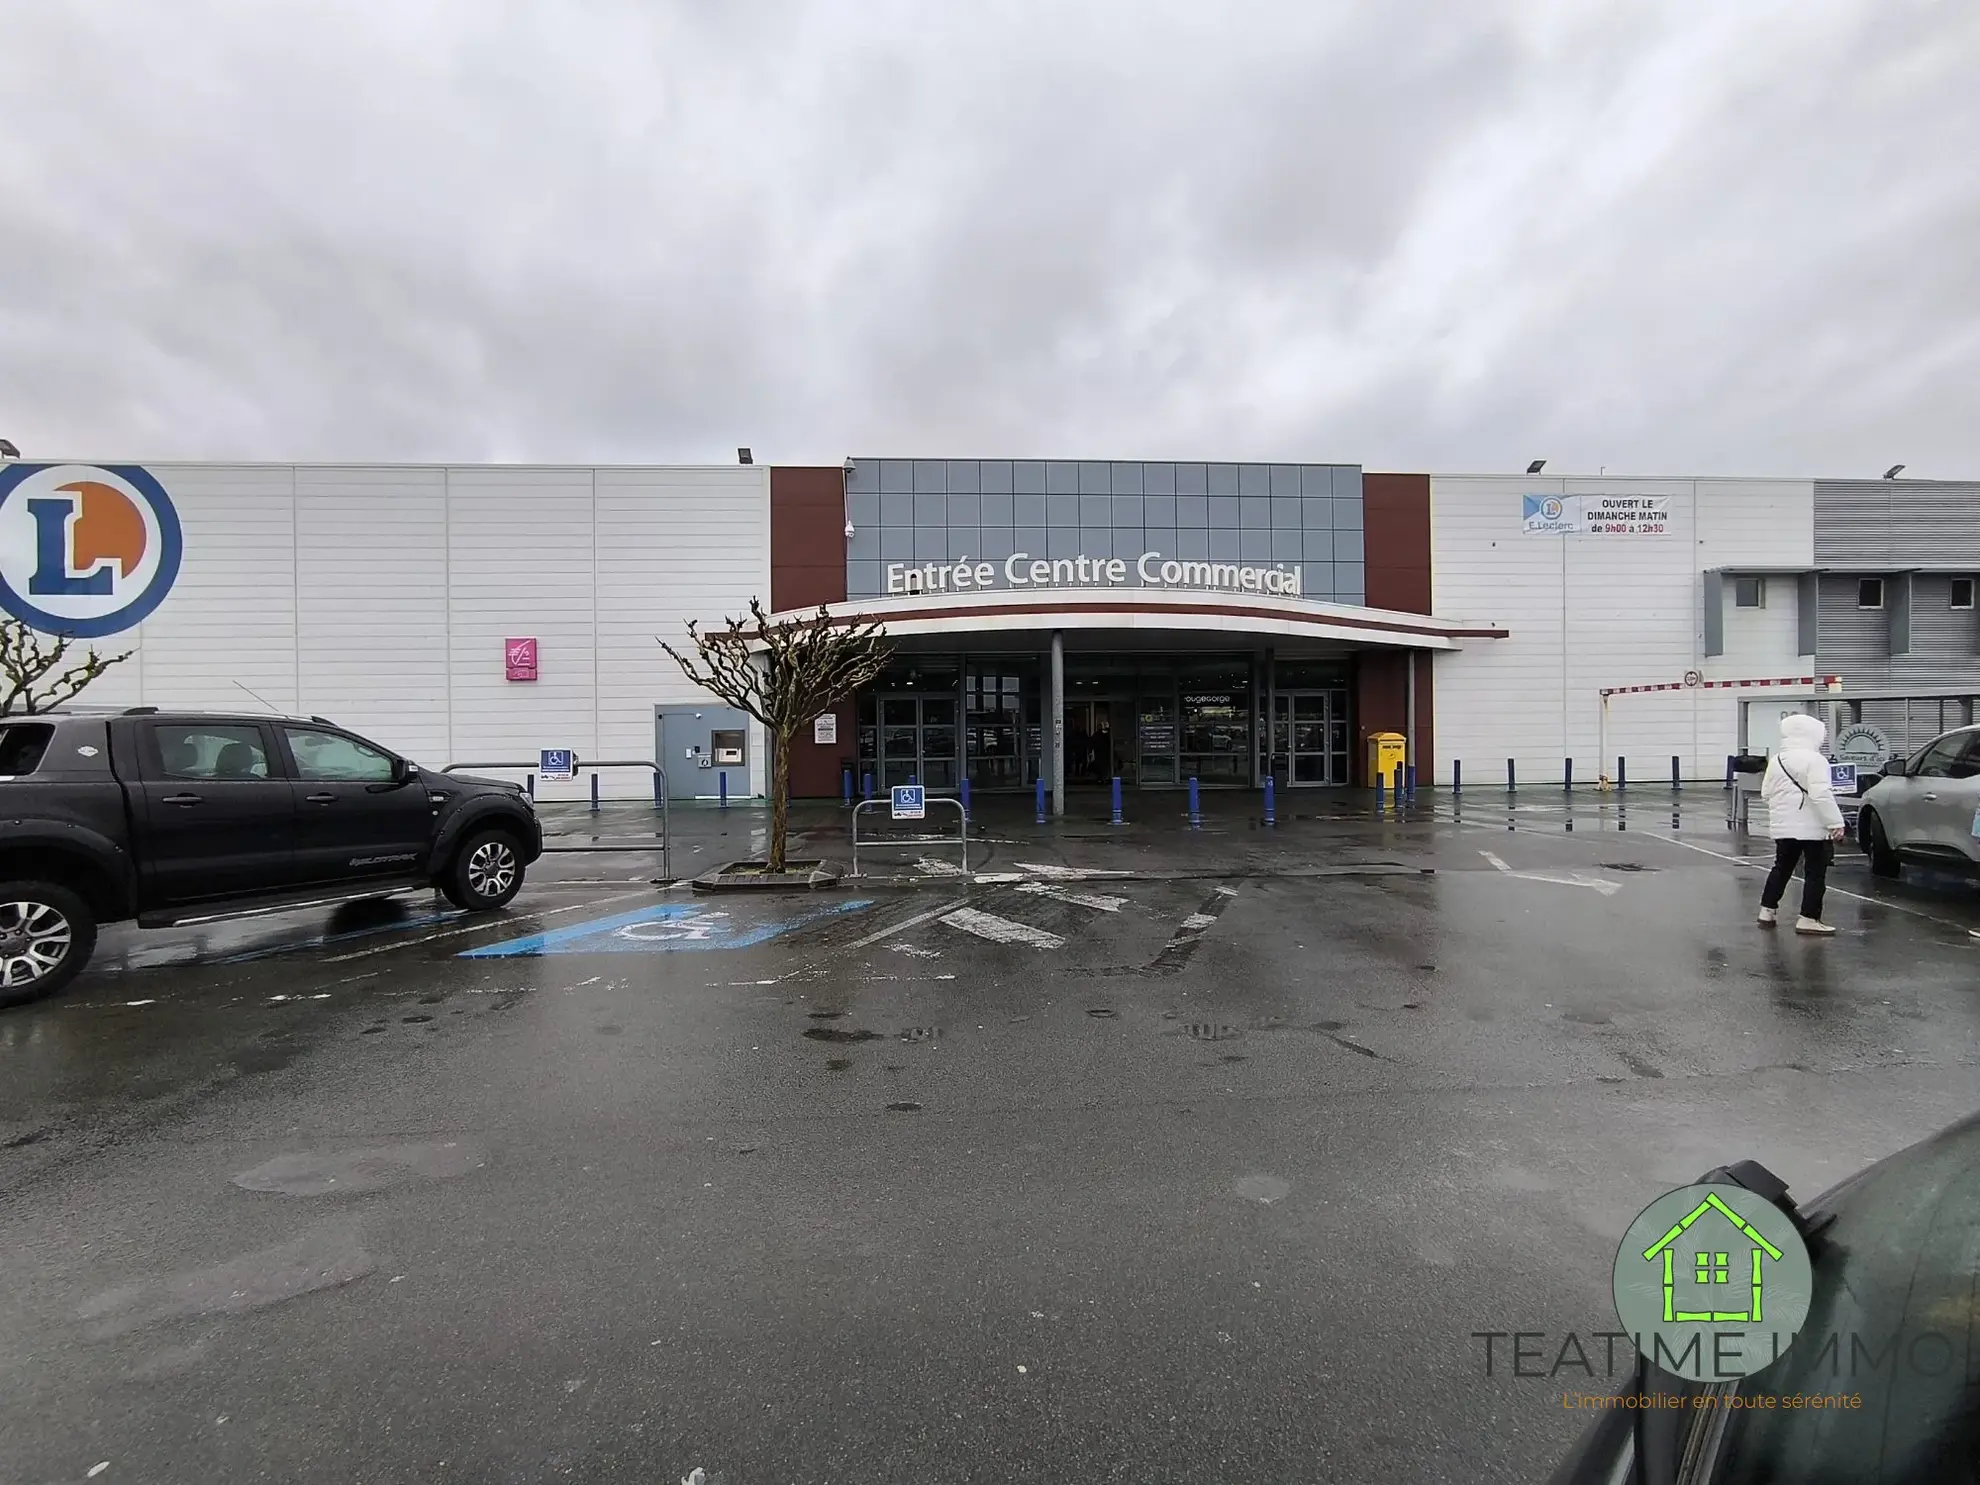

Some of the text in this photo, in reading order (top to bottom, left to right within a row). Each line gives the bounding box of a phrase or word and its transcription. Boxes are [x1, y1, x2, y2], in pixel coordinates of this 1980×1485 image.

[1602, 499, 1653, 508] OUVERT LE
[1587, 511, 1668, 521] DIMANCHE MATIN
[1591, 524, 1602, 533] de
[1605, 524, 1627, 533] 9h00
[1637, 524, 1664, 533] 12h30
[27, 499, 113, 595] L
[887, 550, 1301, 595] Entrée Centre Commercial
